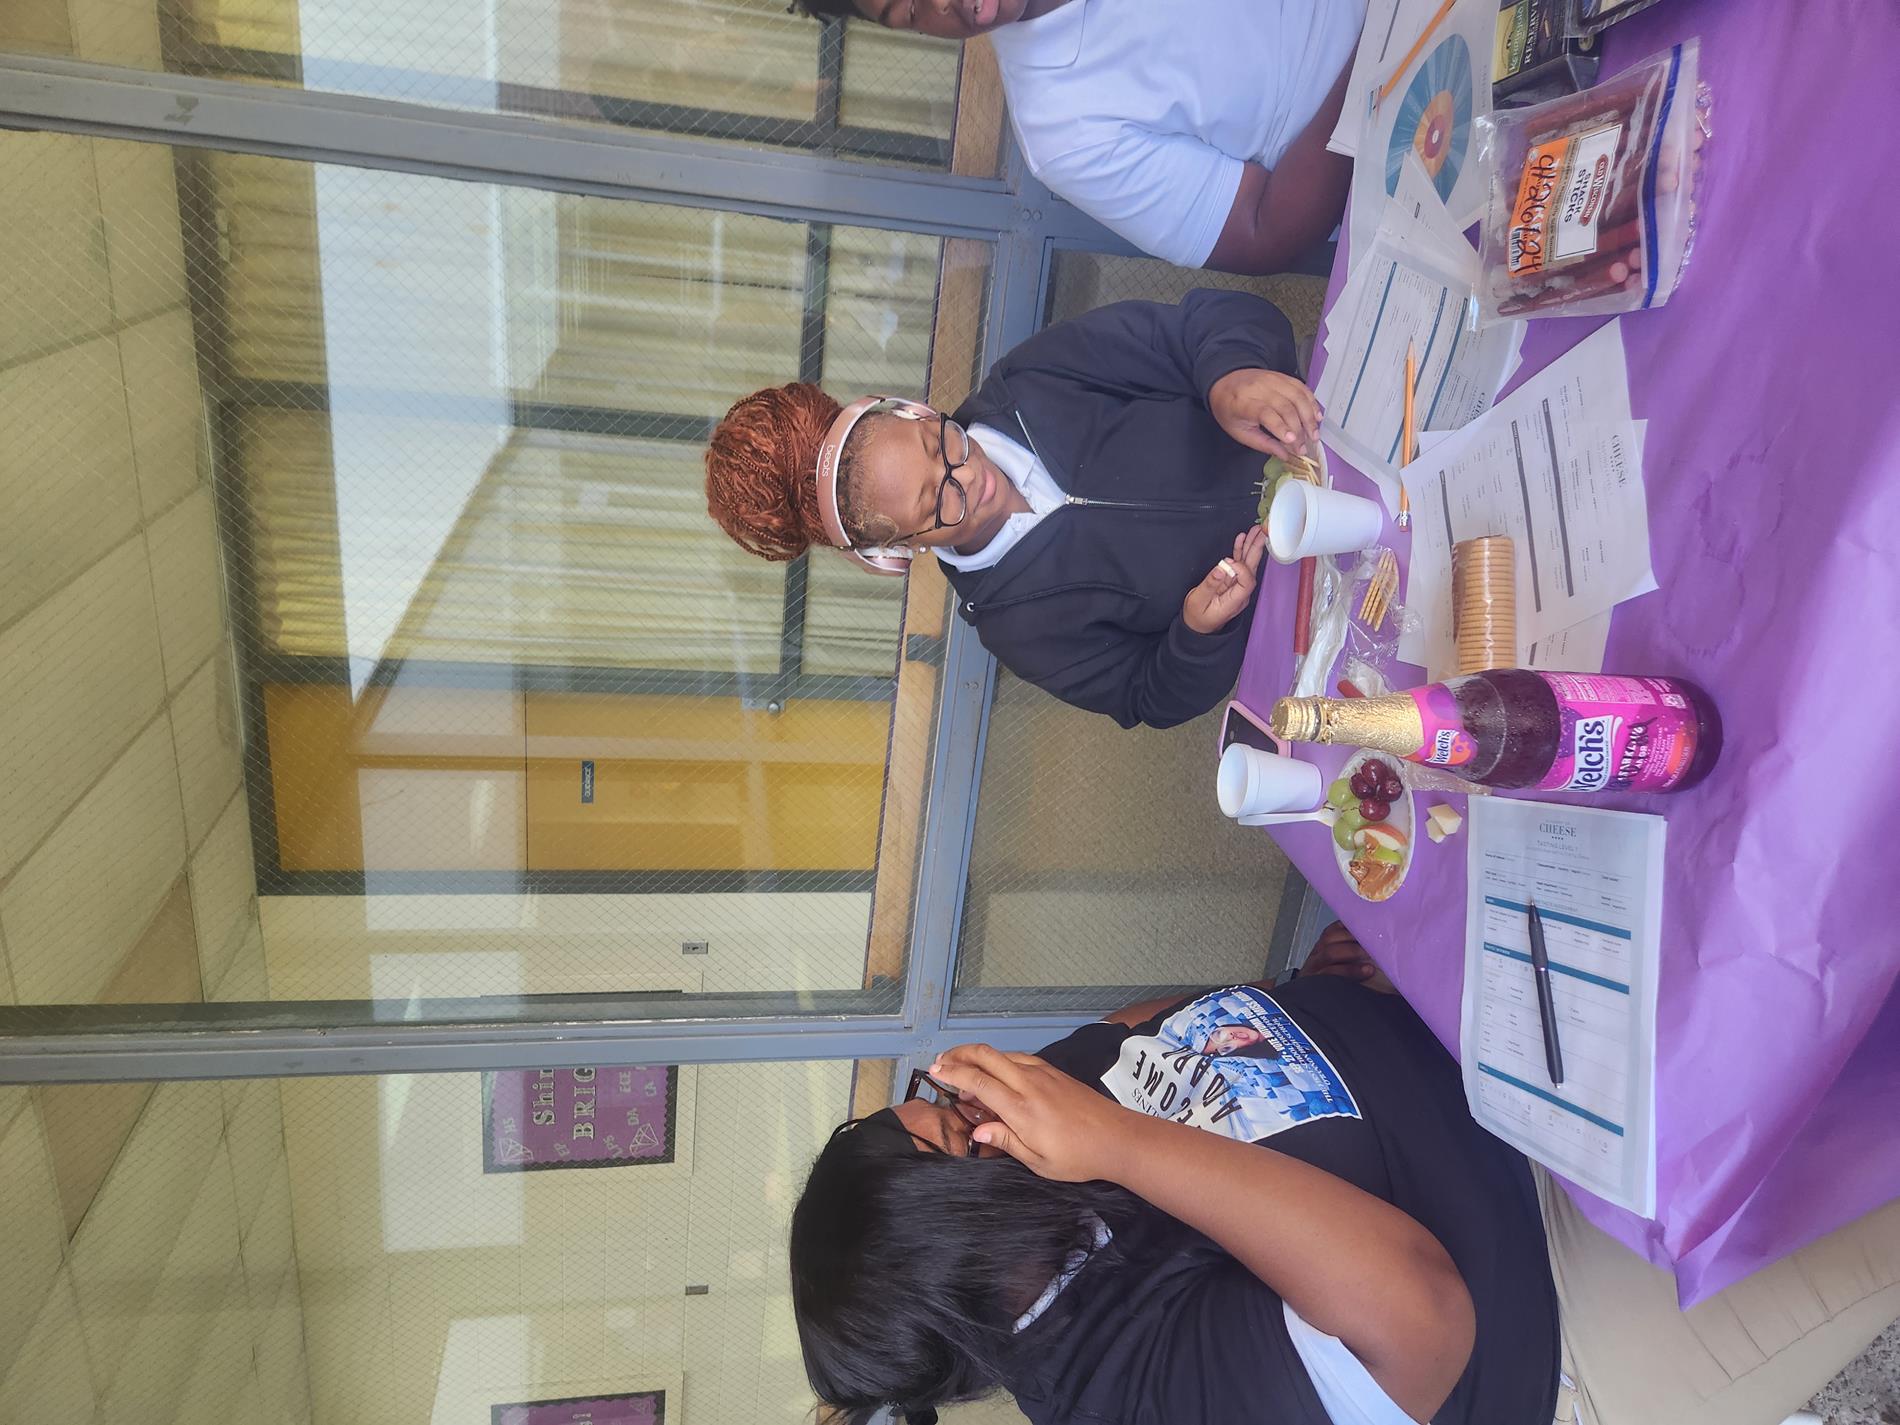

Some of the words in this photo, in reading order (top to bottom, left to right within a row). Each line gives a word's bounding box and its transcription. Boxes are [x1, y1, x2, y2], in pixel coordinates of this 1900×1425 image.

[1597, 161, 1605, 176] OLD
[1564, 168, 1587, 223] STICKS
[1574, 172, 1591, 213] SNACK
[821, 444, 835, 477] beats
[1612, 434, 1626, 488] CHEESE
[1433, 731, 1451, 763] Welch's
[1569, 720, 1605, 791] Welch's
[1539, 822, 1577, 838] CHEESE
[1245, 1000, 1269, 1016] MISS
[1248, 1017, 1275, 1038] AUTUMN
[1260, 1015, 1277, 1026] FOR
[1272, 1017, 1294, 1039] SCHOOL
[1267, 1037, 1285, 1051] VOTE
[1273, 1025, 1292, 1046] CHOICE
[1289, 1062, 1304, 1074] SEP
[1290, 1045, 1310, 1069] SCHOOL
[573, 1067, 596, 1140] BRIG
